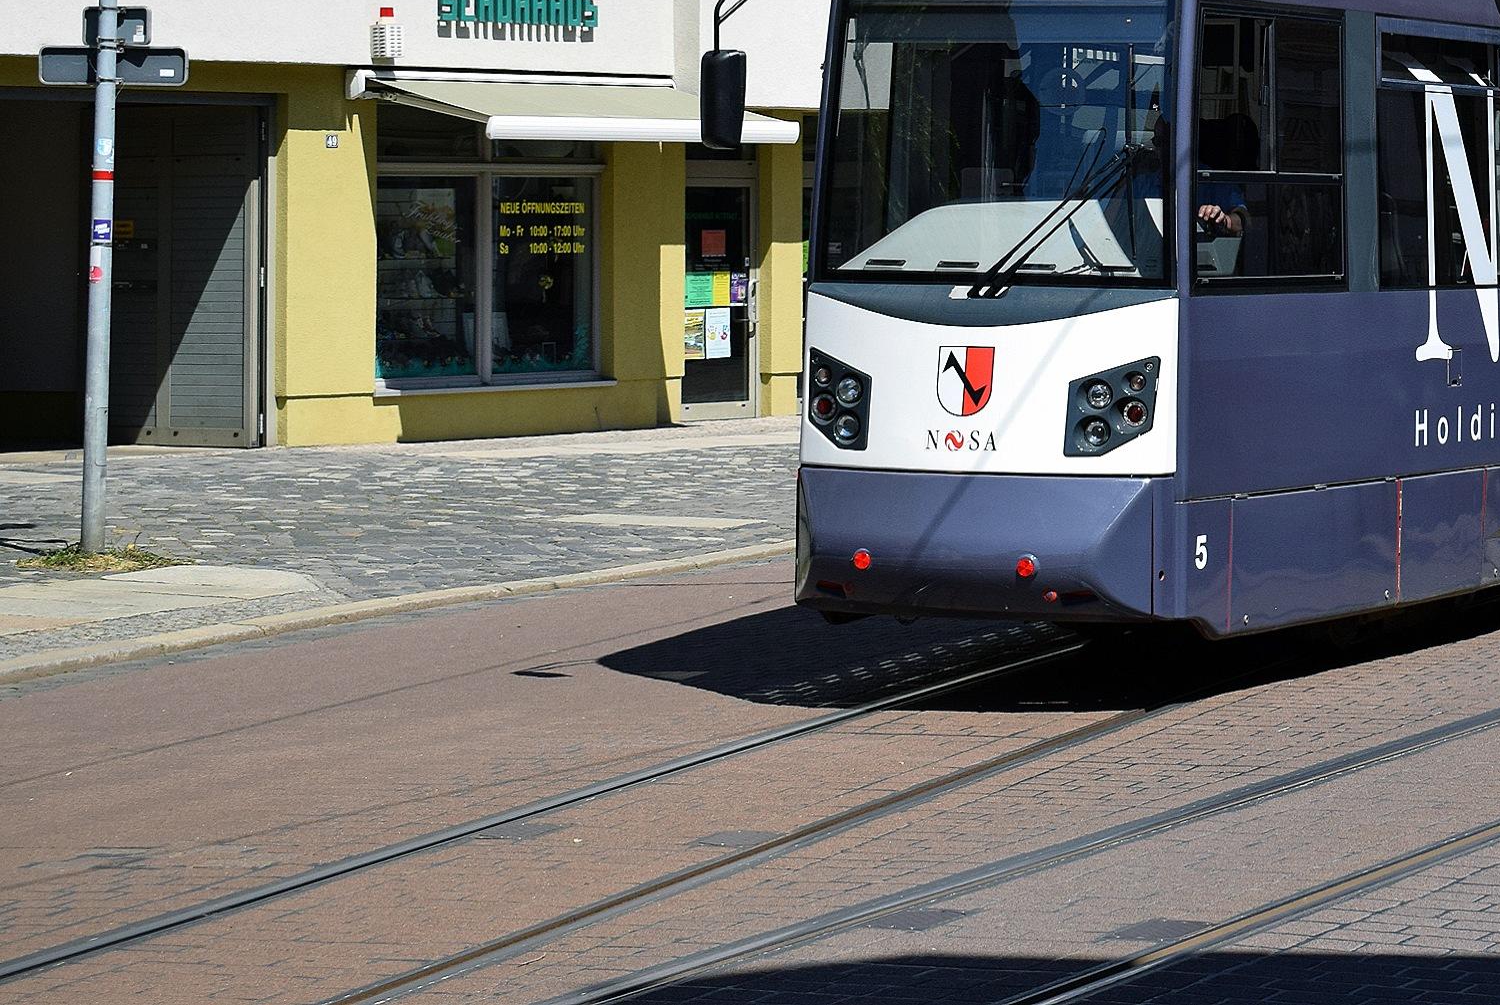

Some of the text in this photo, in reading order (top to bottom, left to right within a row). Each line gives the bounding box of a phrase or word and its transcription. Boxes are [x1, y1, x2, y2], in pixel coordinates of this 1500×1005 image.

[500, 199, 585, 214] NEUE ÖFFNUNGSZEITEN
[500, 225, 510, 237] Mo
[516, 225, 524, 236] Fr
[529, 225, 548, 237] 10:00
[553, 225, 572, 236] 17:00
[573, 225, 585, 236] Uhr
[500, 243, 509, 254] Sa
[529, 242, 548, 254] 10:00
[554, 242, 572, 254] 12:00
[573, 242, 585, 253] Uhr
[1194, 534, 1208, 570] 5
